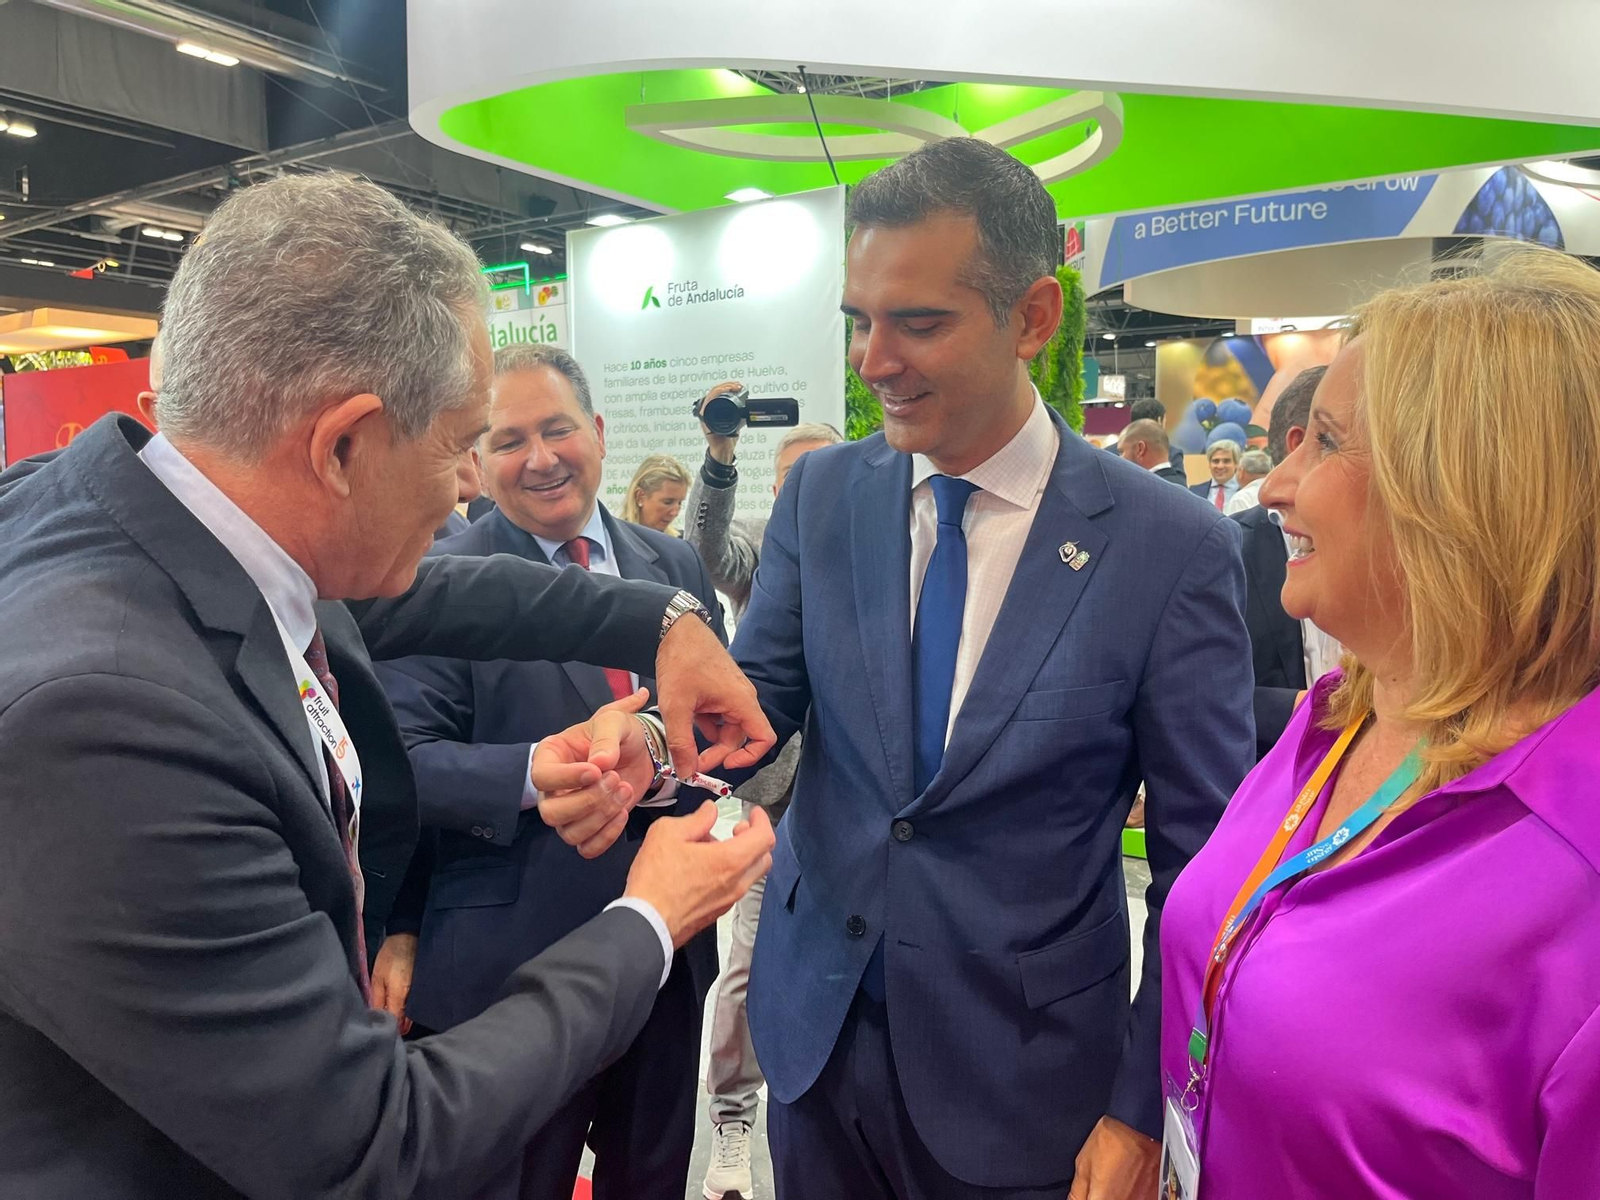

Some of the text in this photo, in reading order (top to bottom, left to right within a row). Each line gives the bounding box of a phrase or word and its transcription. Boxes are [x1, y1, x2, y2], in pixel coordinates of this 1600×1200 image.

[1134, 201, 1328, 240] a Better Future
[667, 280, 698, 294] Fruta
[667, 284, 745, 307] de Andalucía
[603, 351, 755, 373] Hace 10 años cinco empresas
[604, 365, 788, 388] familiares de la provincia de Huelva,
[752, 381, 789, 394] cultivo
[792, 380, 807, 391] de
[604, 394, 623, 404] con
[625, 390, 658, 404] amplia
[605, 405, 694, 419] fresas, frambuesa
[605, 427, 611, 436] y
[653, 421, 687, 432] inician
[606, 441, 621, 451] que
[625, 439, 639, 449] da
[640, 439, 664, 451] lugar
[667, 437, 676, 447] al
[740, 432, 767, 444] de la
[750, 484, 764, 493] es
[313, 695, 330, 717] fruit
[306, 704, 338, 749] attraction
[335, 736, 349, 759] 15
